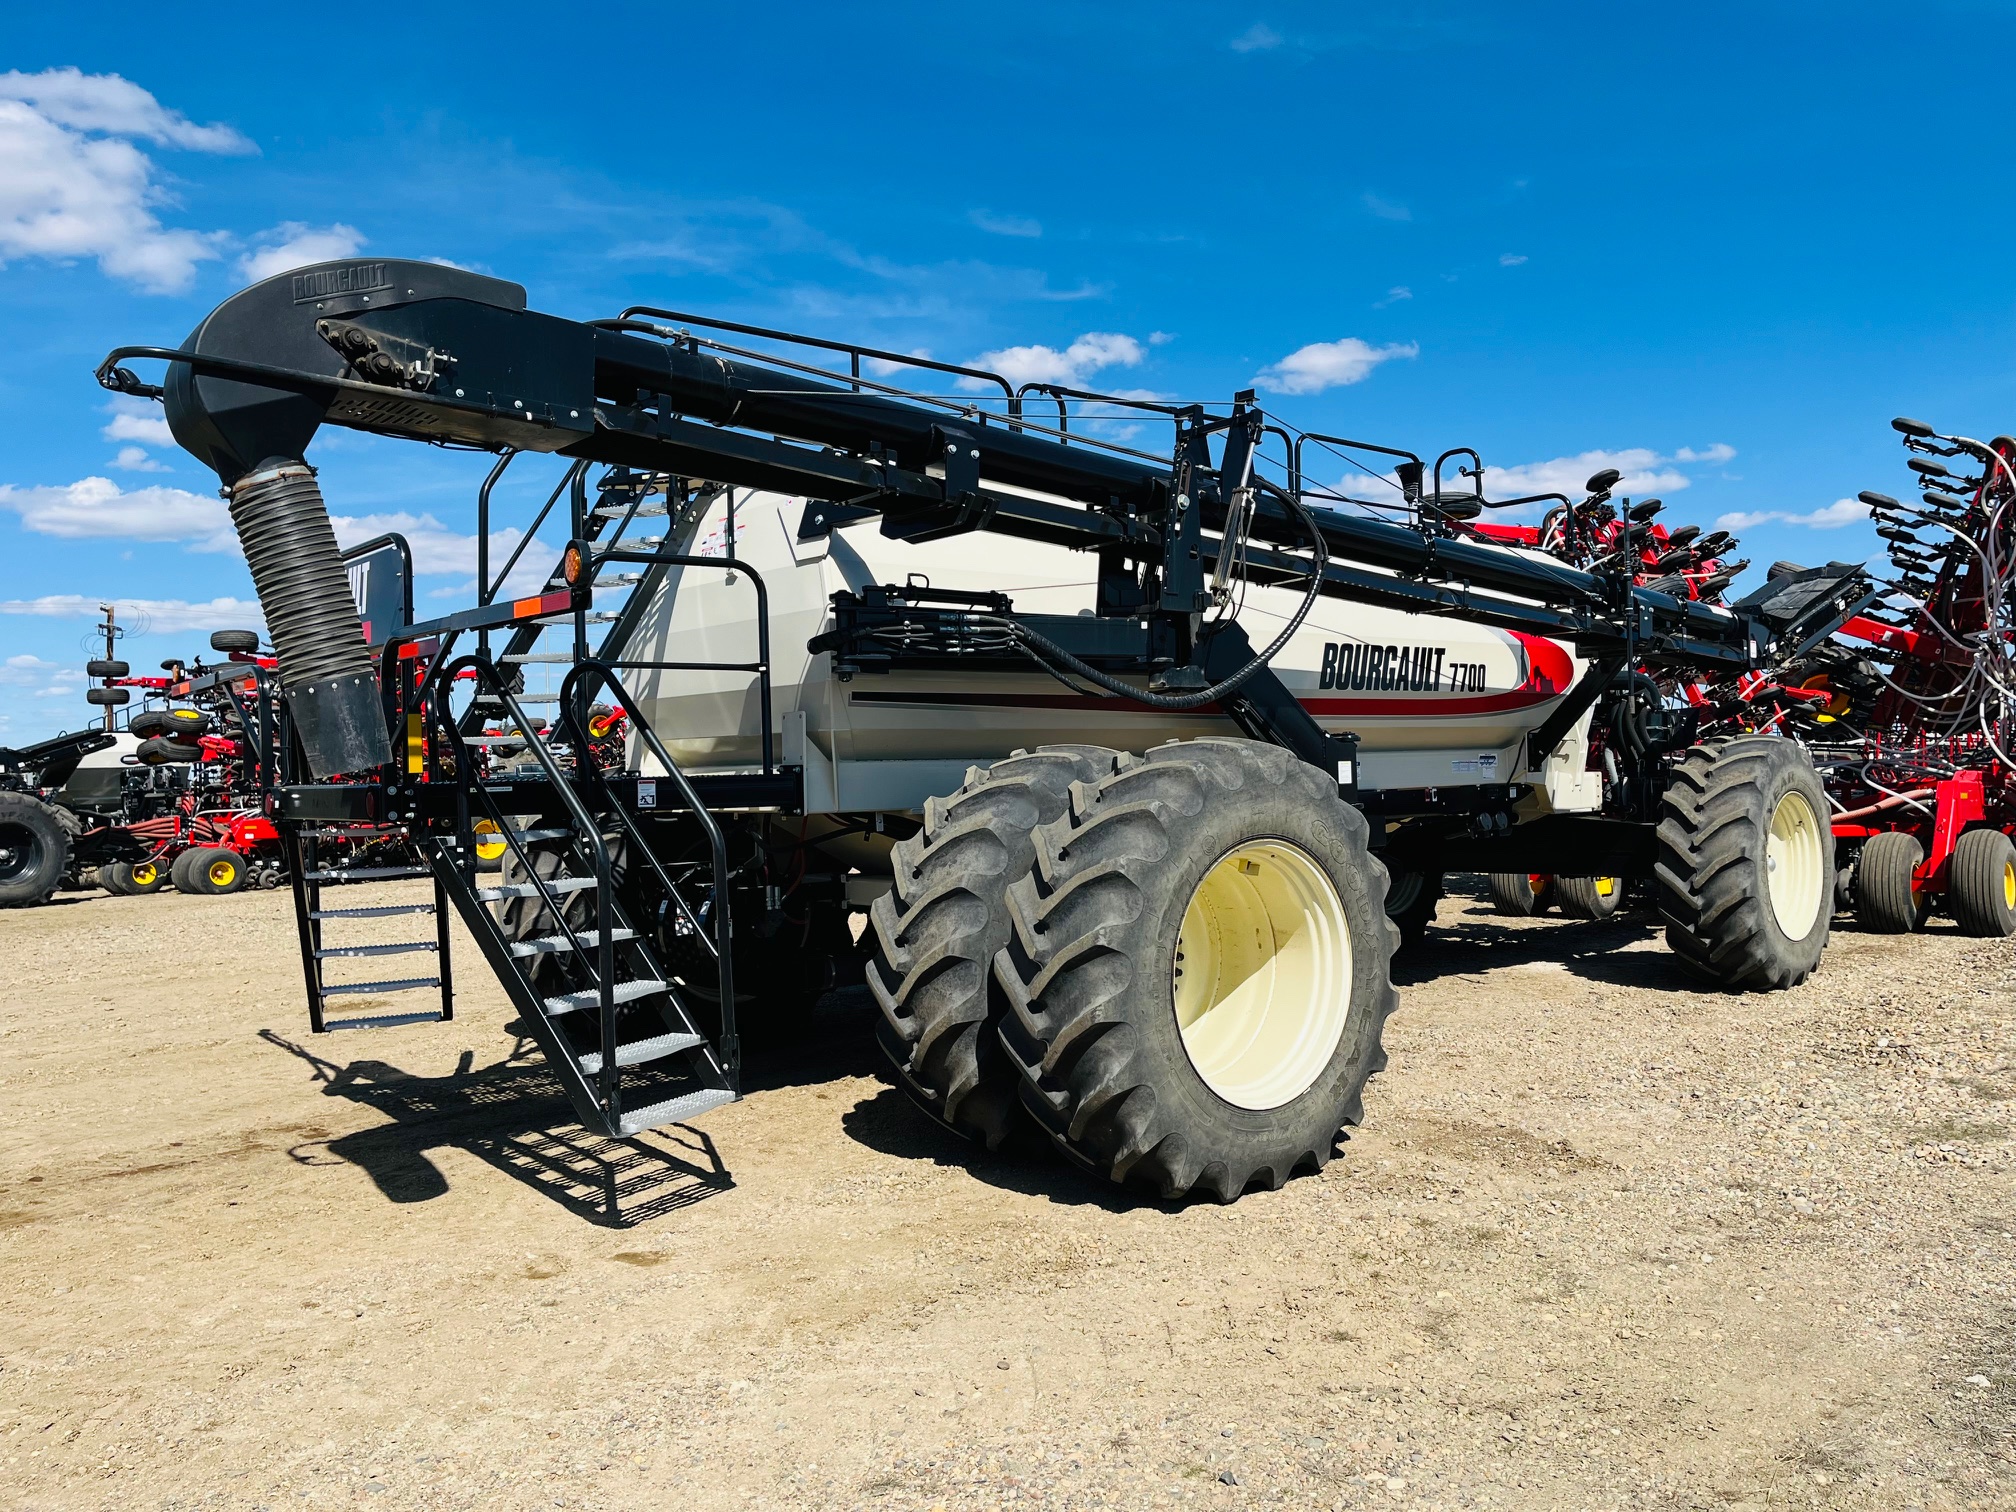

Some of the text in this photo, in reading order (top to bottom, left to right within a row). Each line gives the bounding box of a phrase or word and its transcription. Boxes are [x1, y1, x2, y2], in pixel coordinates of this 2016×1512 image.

[292, 263, 387, 300] BOURGAULT
[1319, 642, 1486, 692] BOURGAULT 7700
